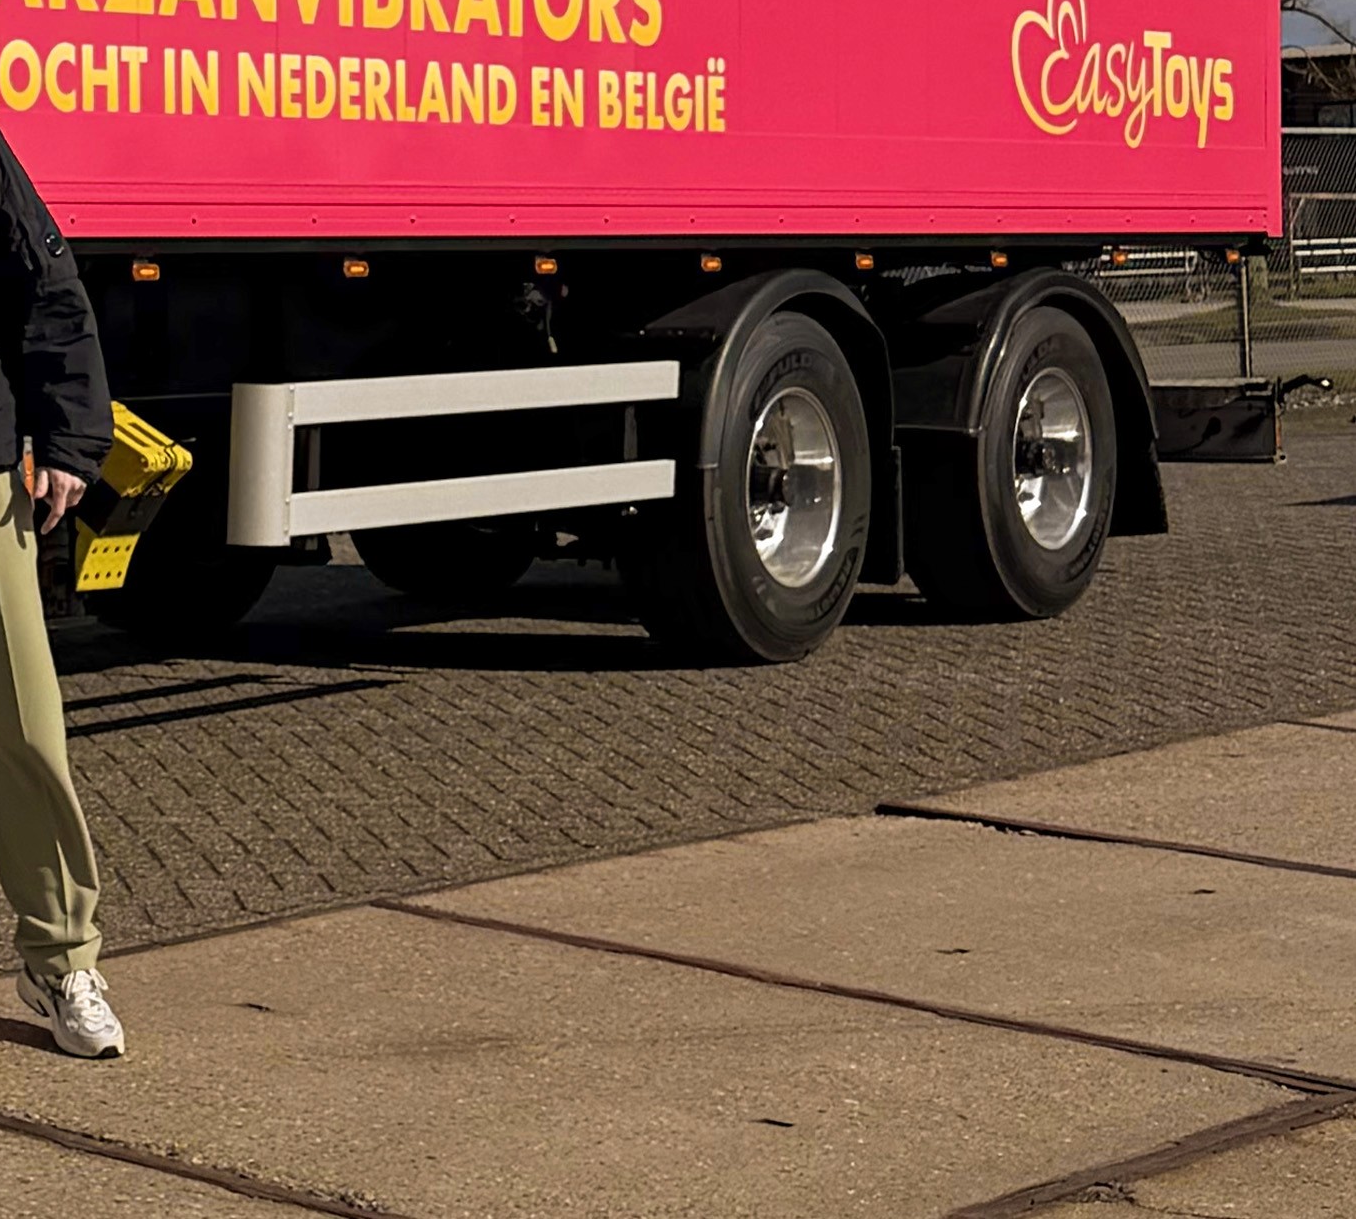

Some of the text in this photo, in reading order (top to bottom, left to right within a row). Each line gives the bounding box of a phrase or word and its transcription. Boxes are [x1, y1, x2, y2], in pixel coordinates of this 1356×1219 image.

[164, 48, 219, 115] IN
[238, 52, 517, 125] NEDERLAND
[531, 67, 584, 127] EN
[598, 57, 726, 132] BELGIË
